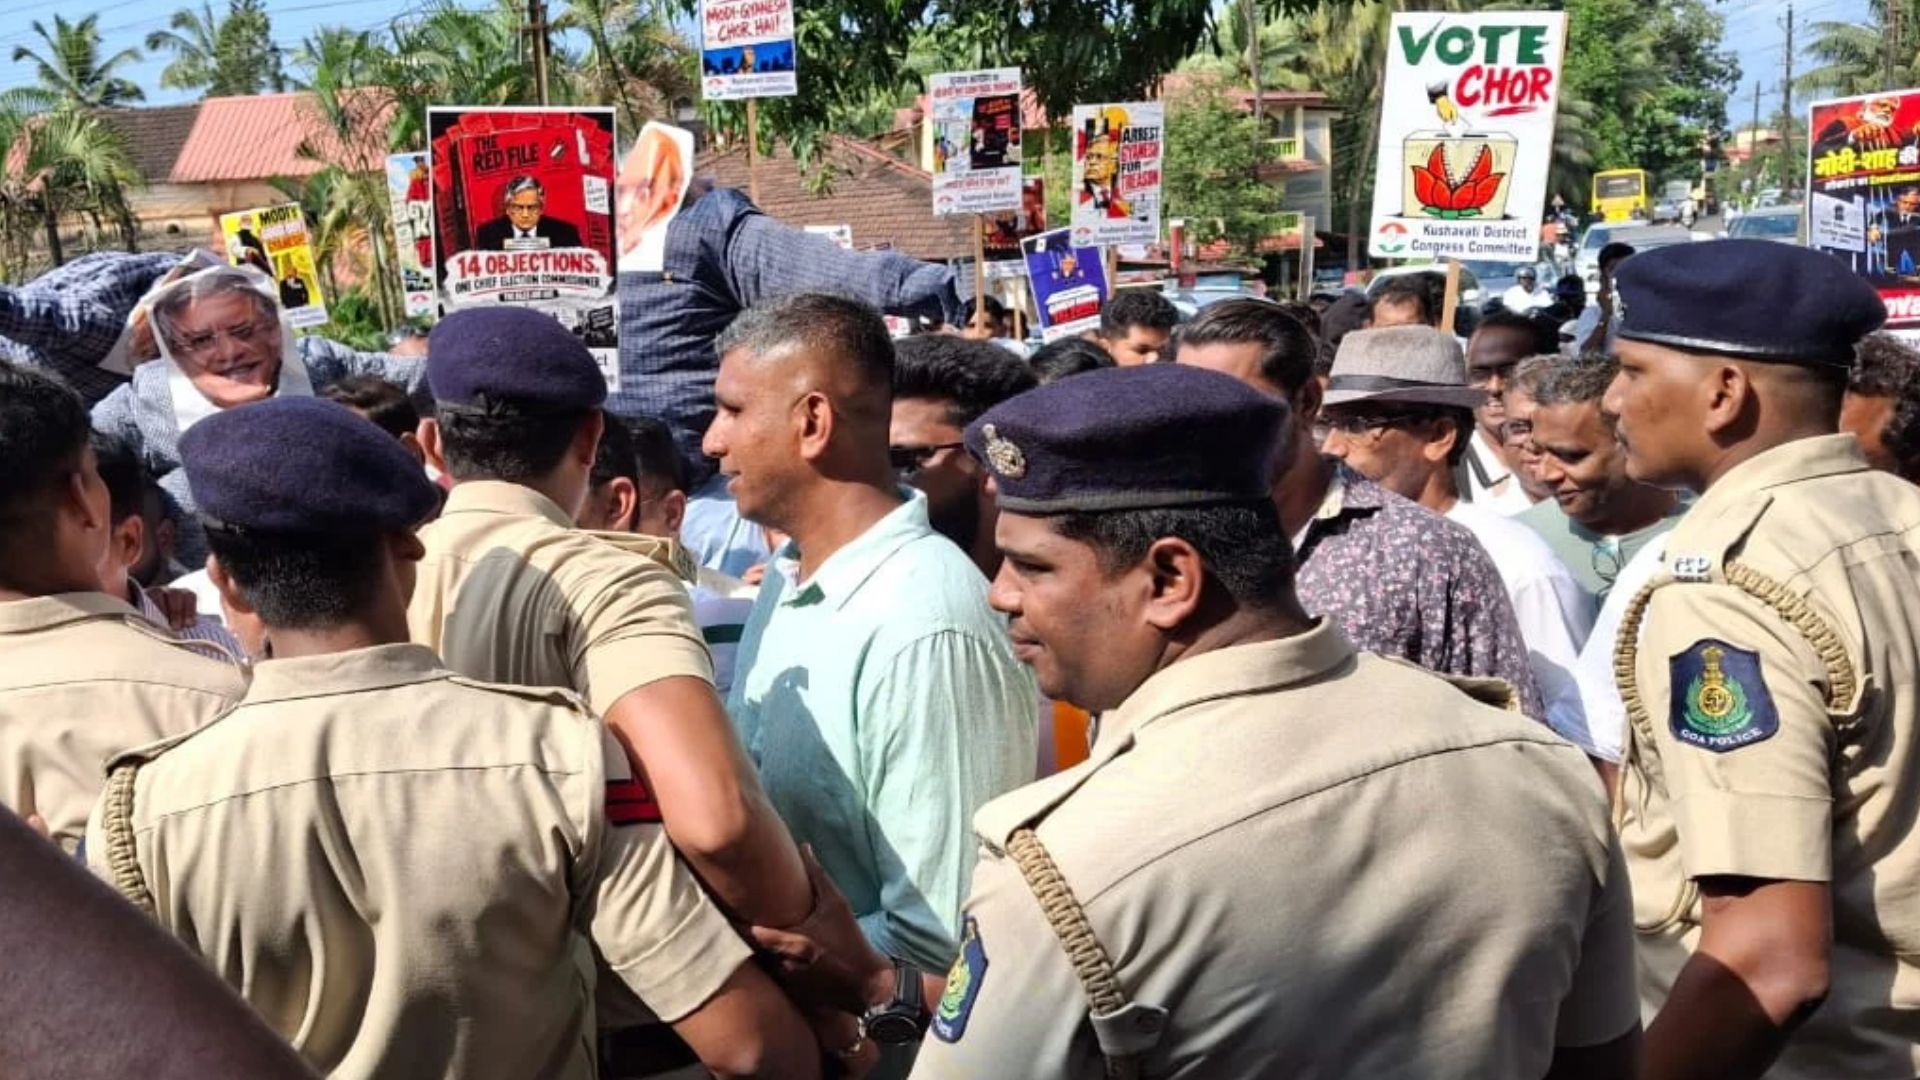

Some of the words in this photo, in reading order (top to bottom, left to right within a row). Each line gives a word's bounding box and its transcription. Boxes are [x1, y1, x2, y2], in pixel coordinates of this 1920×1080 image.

[717, 21, 752, 41] CHOR
[1397, 16, 1550, 65] VOTE
[1455, 65, 1553, 107] CHOR
[474, 134, 497, 150] THE
[1123, 127, 1160, 143] ARREST
[473, 150, 503, 171] RED
[507, 144, 540, 166] FILE
[1121, 161, 1141, 172] FOR
[1423, 226, 1479, 237] Kushavati
[1484, 227, 1527, 238] District
[1411, 240, 1464, 253] Congress
[1468, 241, 1532, 254] Committee
[457, 256, 481, 278] 14
[485, 252, 600, 275] OBJECTIONS.
[455, 283, 471, 294] ONE
[474, 279, 497, 290] CHIEF
[500, 275, 539, 287] ELECTION
[1680, 729, 1706, 744] GOA
[1708, 728, 1763, 745] POLICE
